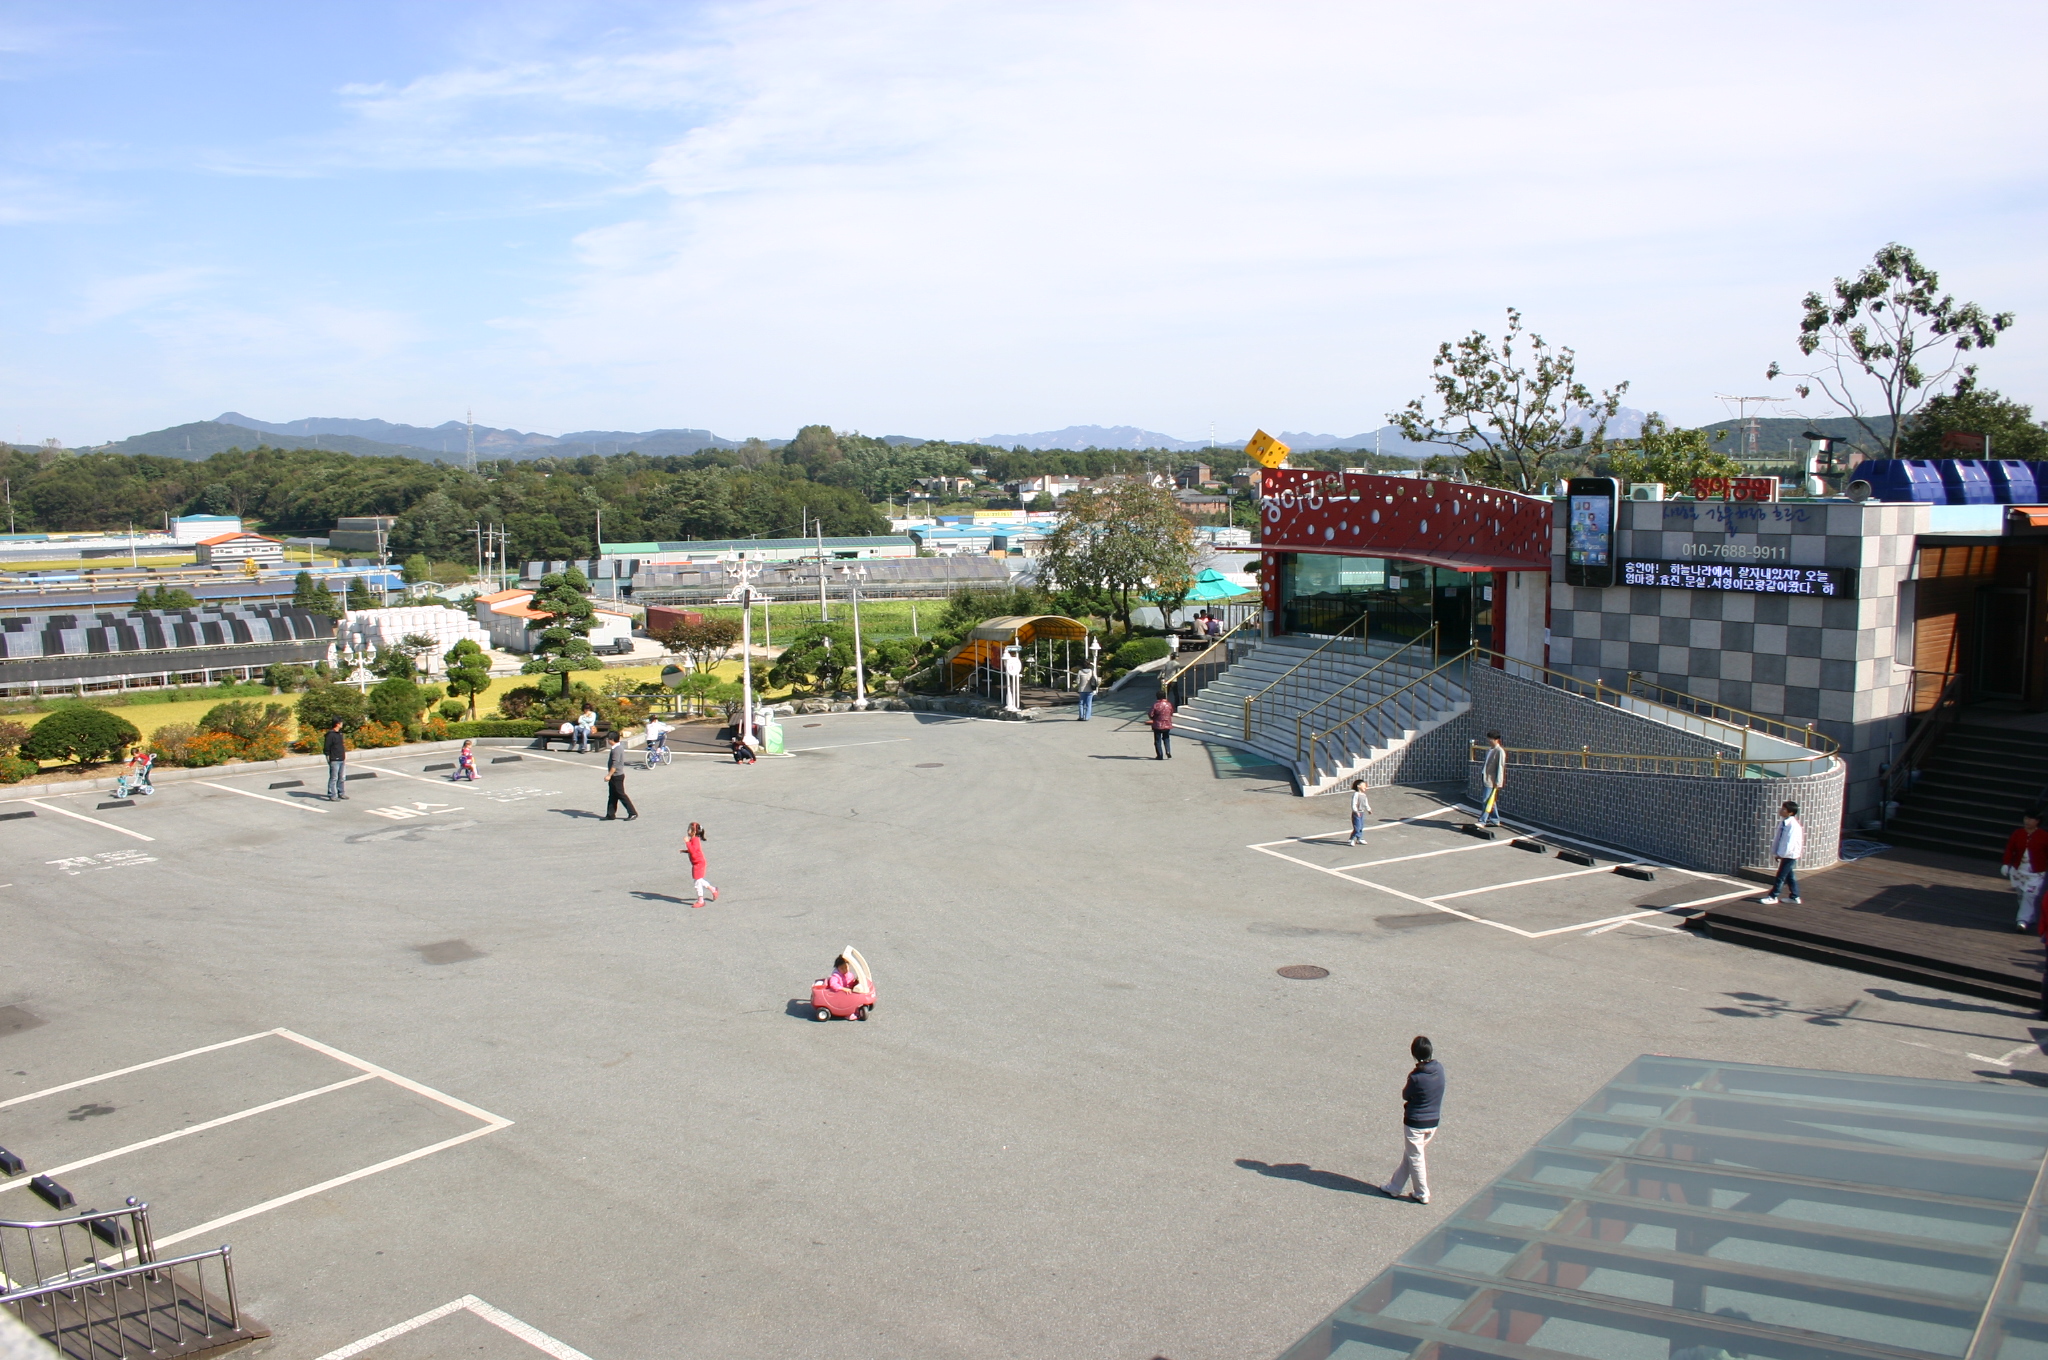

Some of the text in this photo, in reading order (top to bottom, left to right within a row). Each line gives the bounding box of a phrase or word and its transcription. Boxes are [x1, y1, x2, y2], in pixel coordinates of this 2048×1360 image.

[1260, 471, 1347, 523] 청아공원
[1691, 477, 1771, 501] 청아공원
[1772, 505, 1811, 522] 흐르고
[1682, 543, 1787, 560] 010-7688-9911
[1670, 563, 1733, 578] 하늘나라에서
[1805, 570, 1829, 582] 오늘
[1822, 582, 1835, 595] 하
[364, 801, 465, 820] 버스
